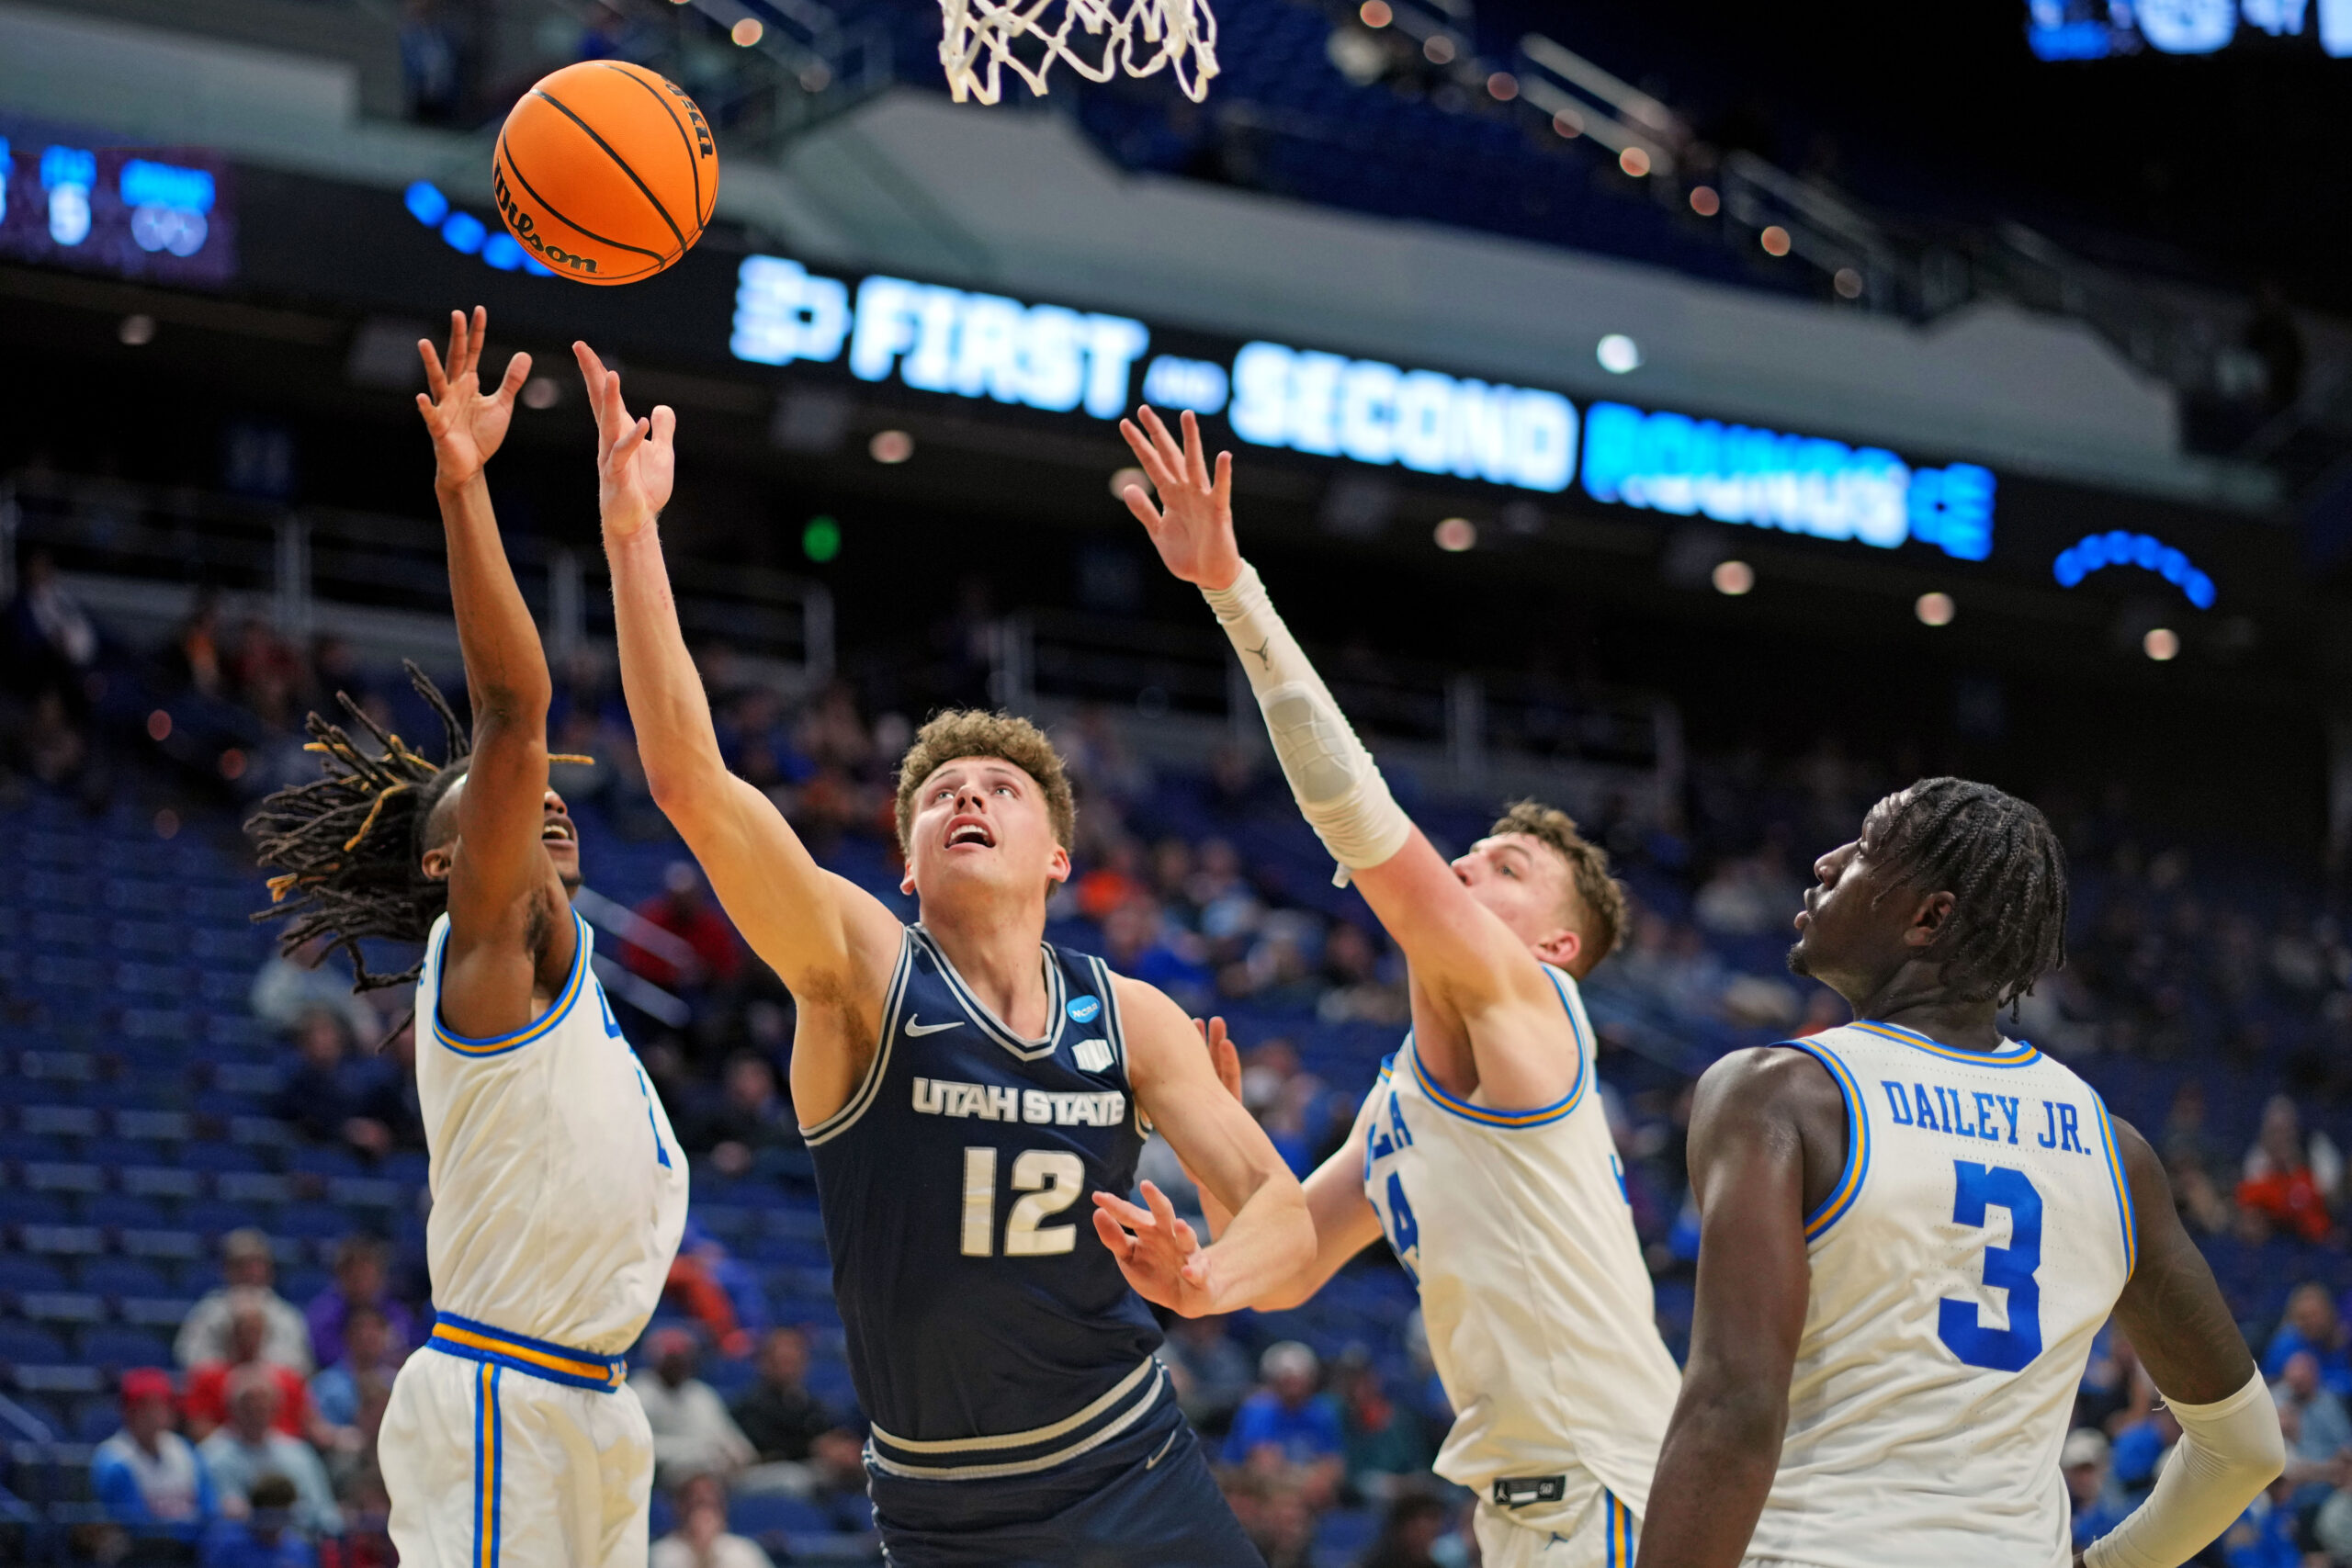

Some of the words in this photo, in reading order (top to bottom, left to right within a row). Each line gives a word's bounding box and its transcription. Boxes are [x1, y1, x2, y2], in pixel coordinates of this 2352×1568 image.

[494, 156, 598, 274] Wilson
[850, 275, 1149, 420] FIRST
[1227, 340, 1578, 493] SECOND
[912, 1077, 1018, 1122] UTAH
[1023, 1089, 1126, 1126] STATE
[1881, 1080, 2019, 1145] DAILEY
[2038, 1100, 2091, 1156] JR.
[961, 1146, 1085, 1257] 12
[1938, 1159, 2042, 1372] 3
